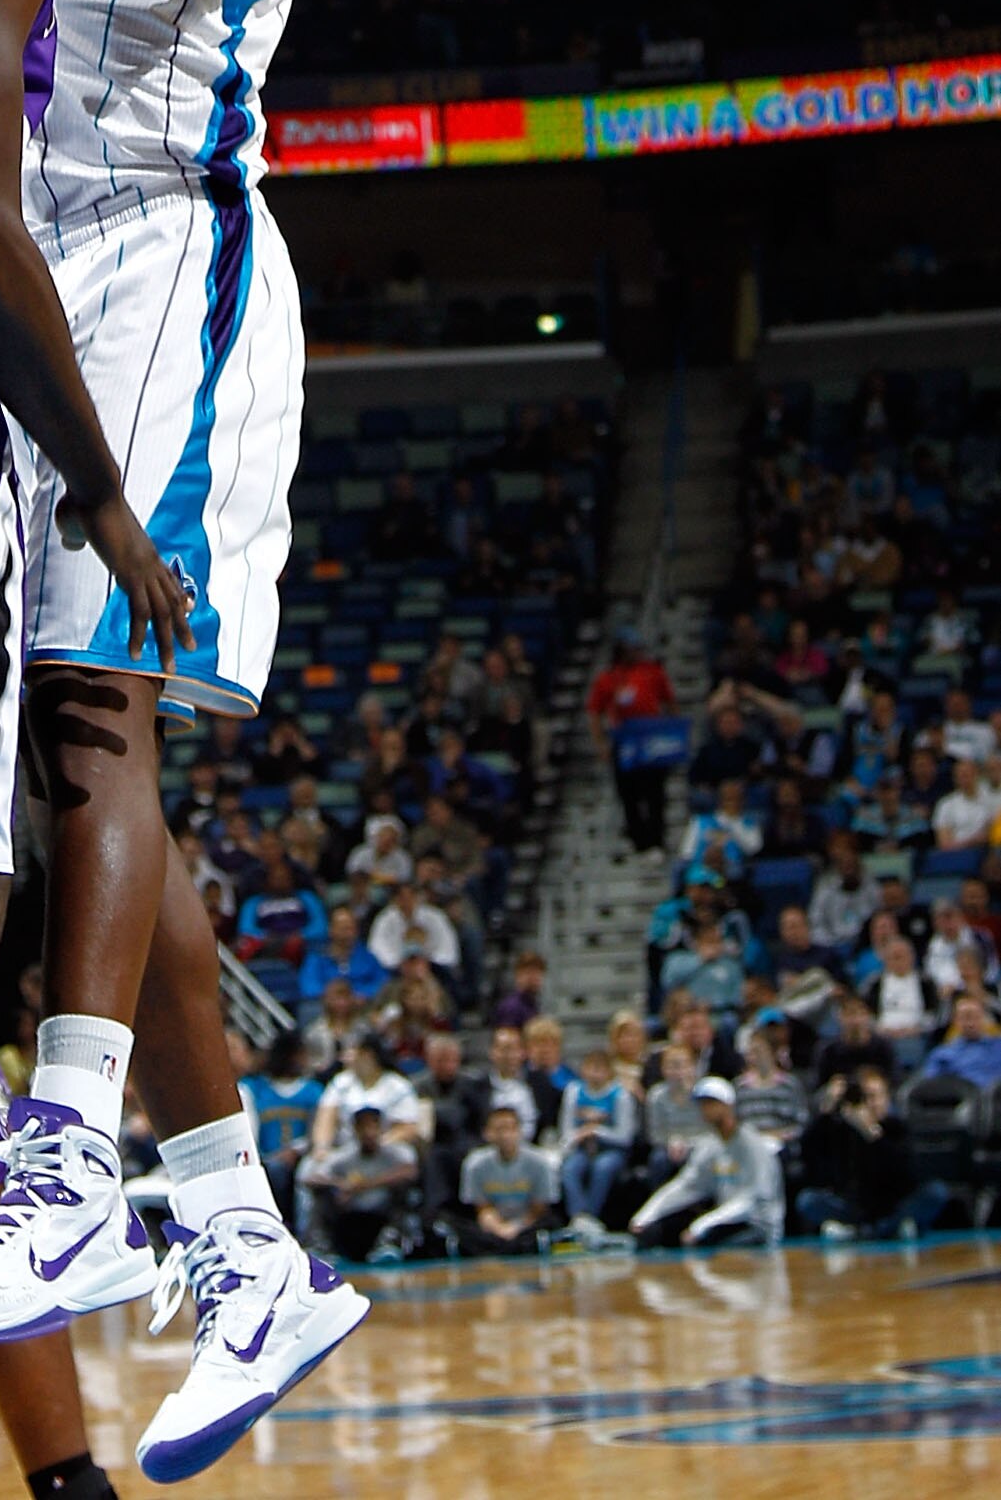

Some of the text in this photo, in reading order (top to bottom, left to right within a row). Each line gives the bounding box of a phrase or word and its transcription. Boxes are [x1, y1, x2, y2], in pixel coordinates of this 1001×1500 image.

[600, 102, 701, 147] WIN
[707, 94, 749, 142] A
[753, 84, 899, 136] GOLD
